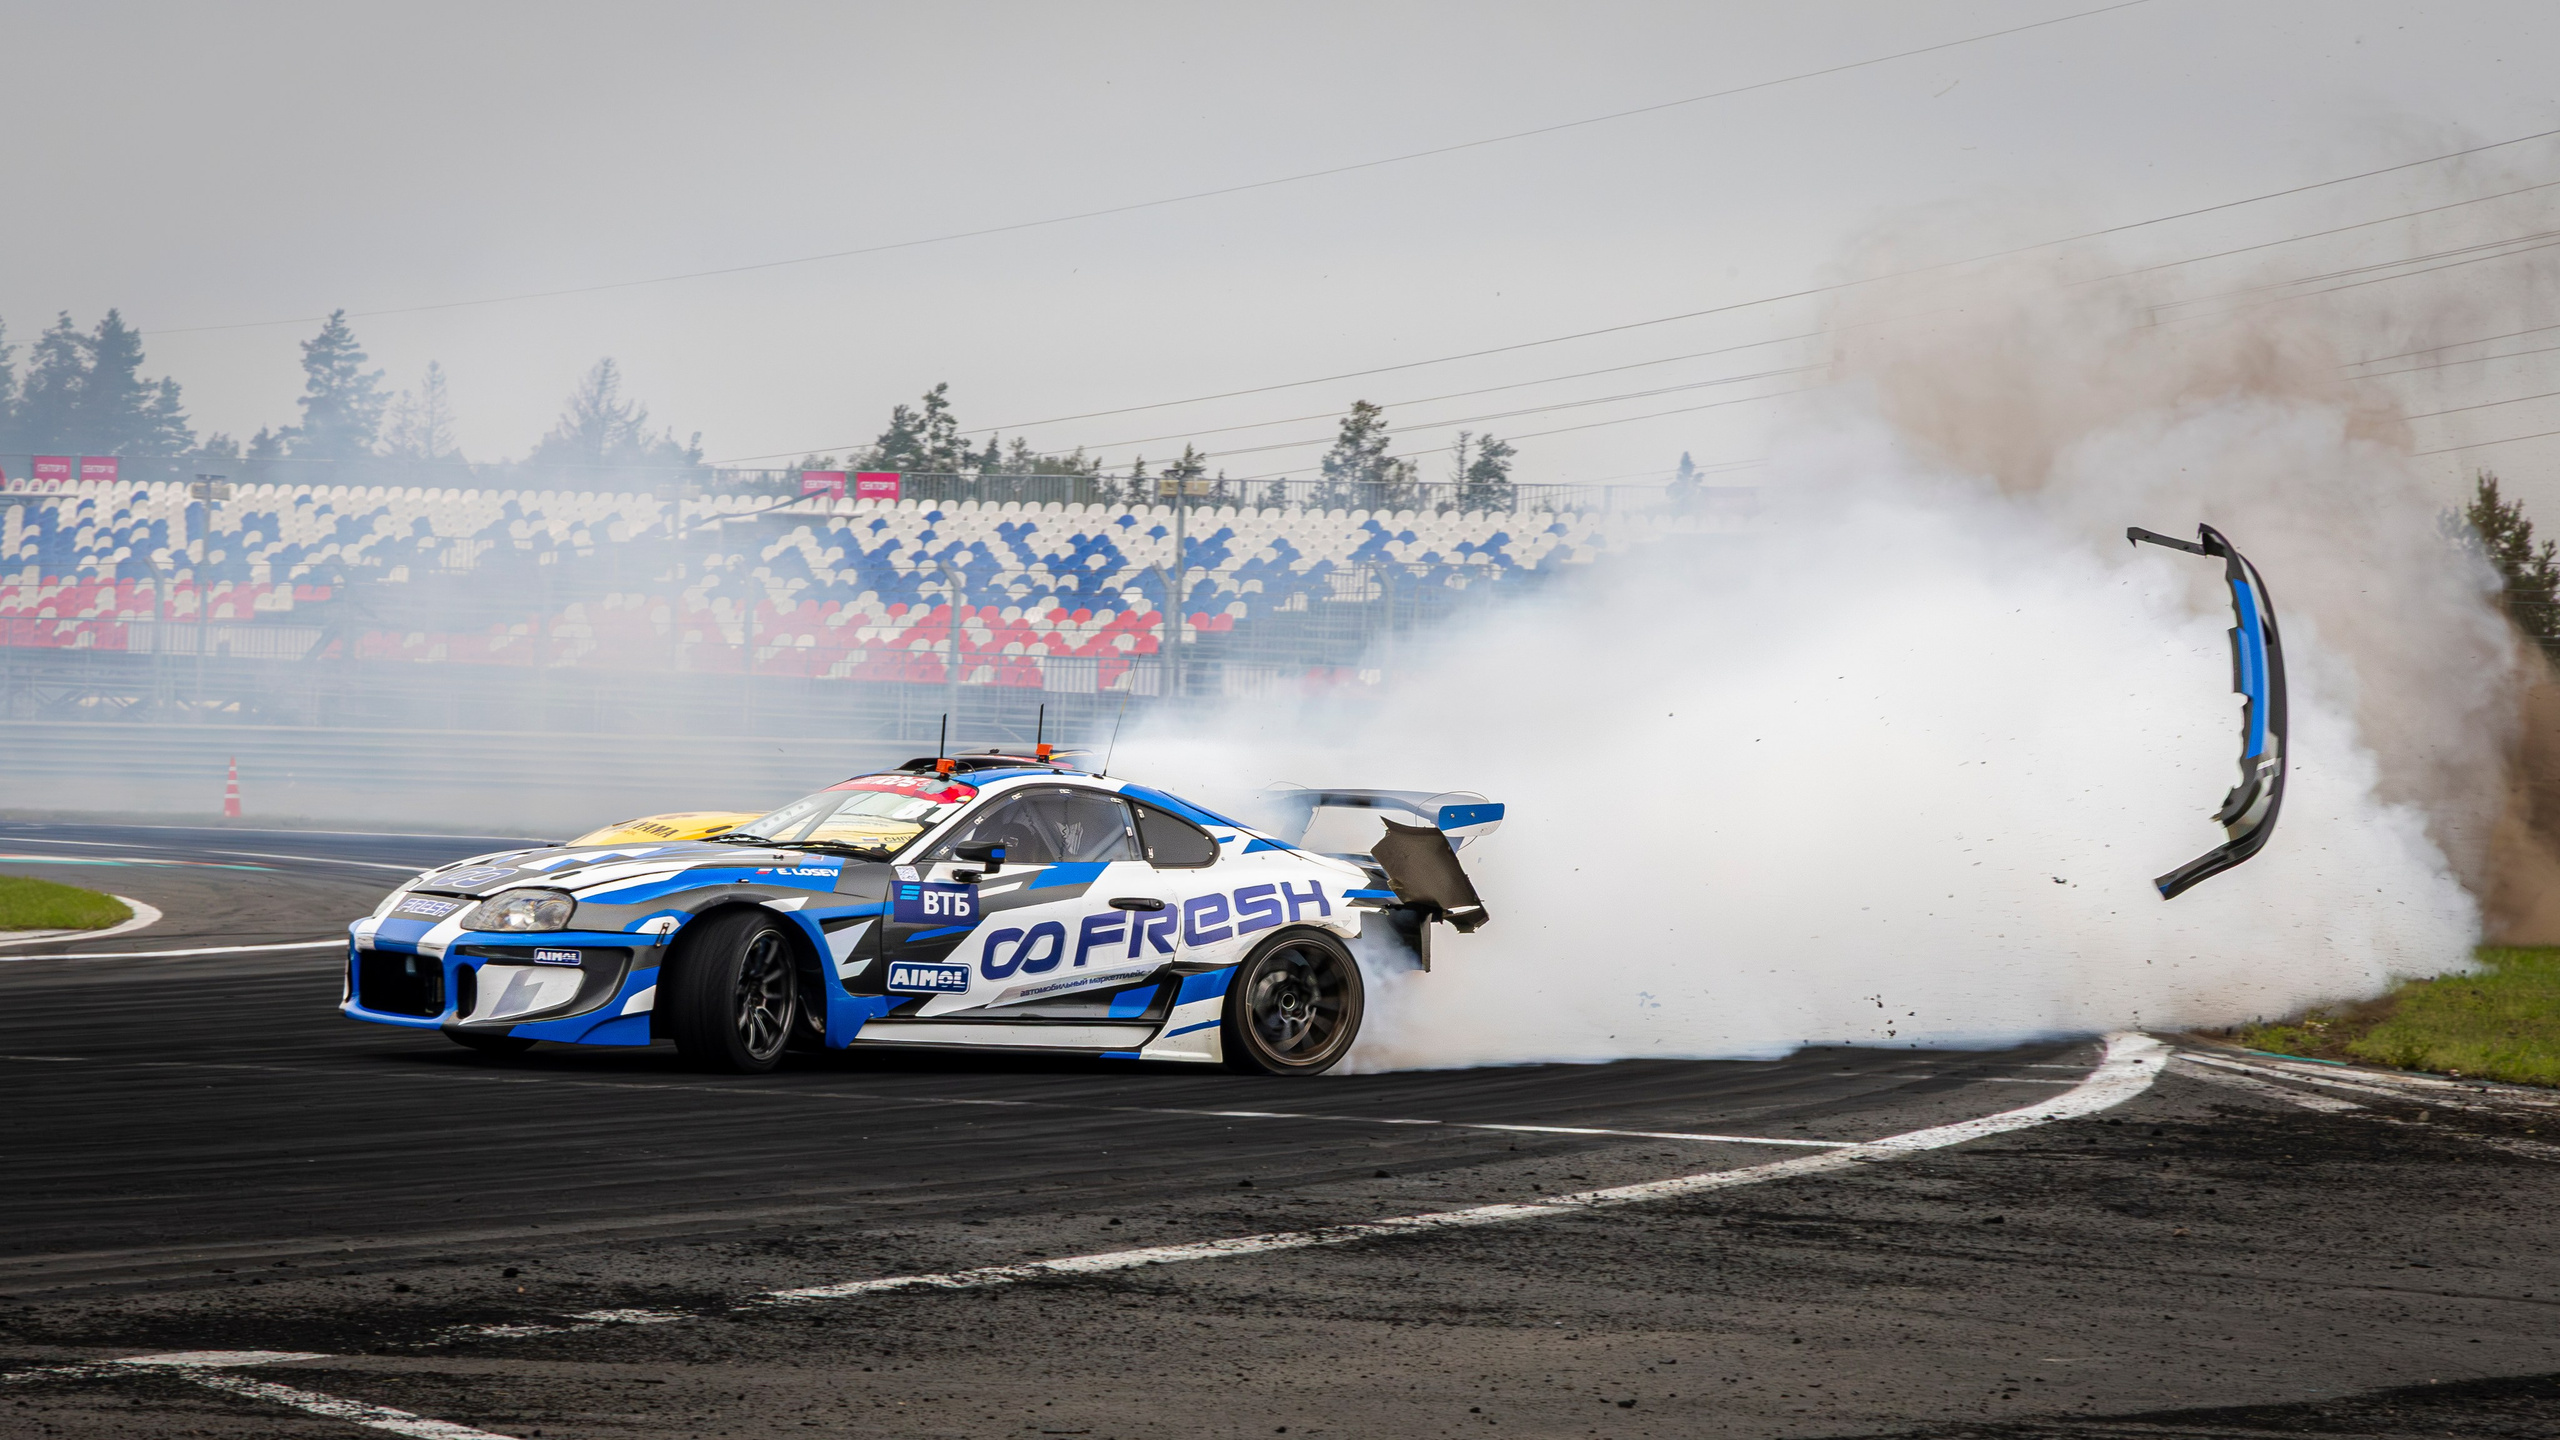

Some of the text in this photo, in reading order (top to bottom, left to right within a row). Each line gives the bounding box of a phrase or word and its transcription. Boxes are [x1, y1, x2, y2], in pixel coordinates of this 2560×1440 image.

[792, 868, 838, 877] LOSEV
[923, 891, 970, 916] ВТБ
[536, 951, 579, 962] AIMOL
[891, 968, 966, 988] AIMOL
[1020, 977, 1088, 997] автомобильный
